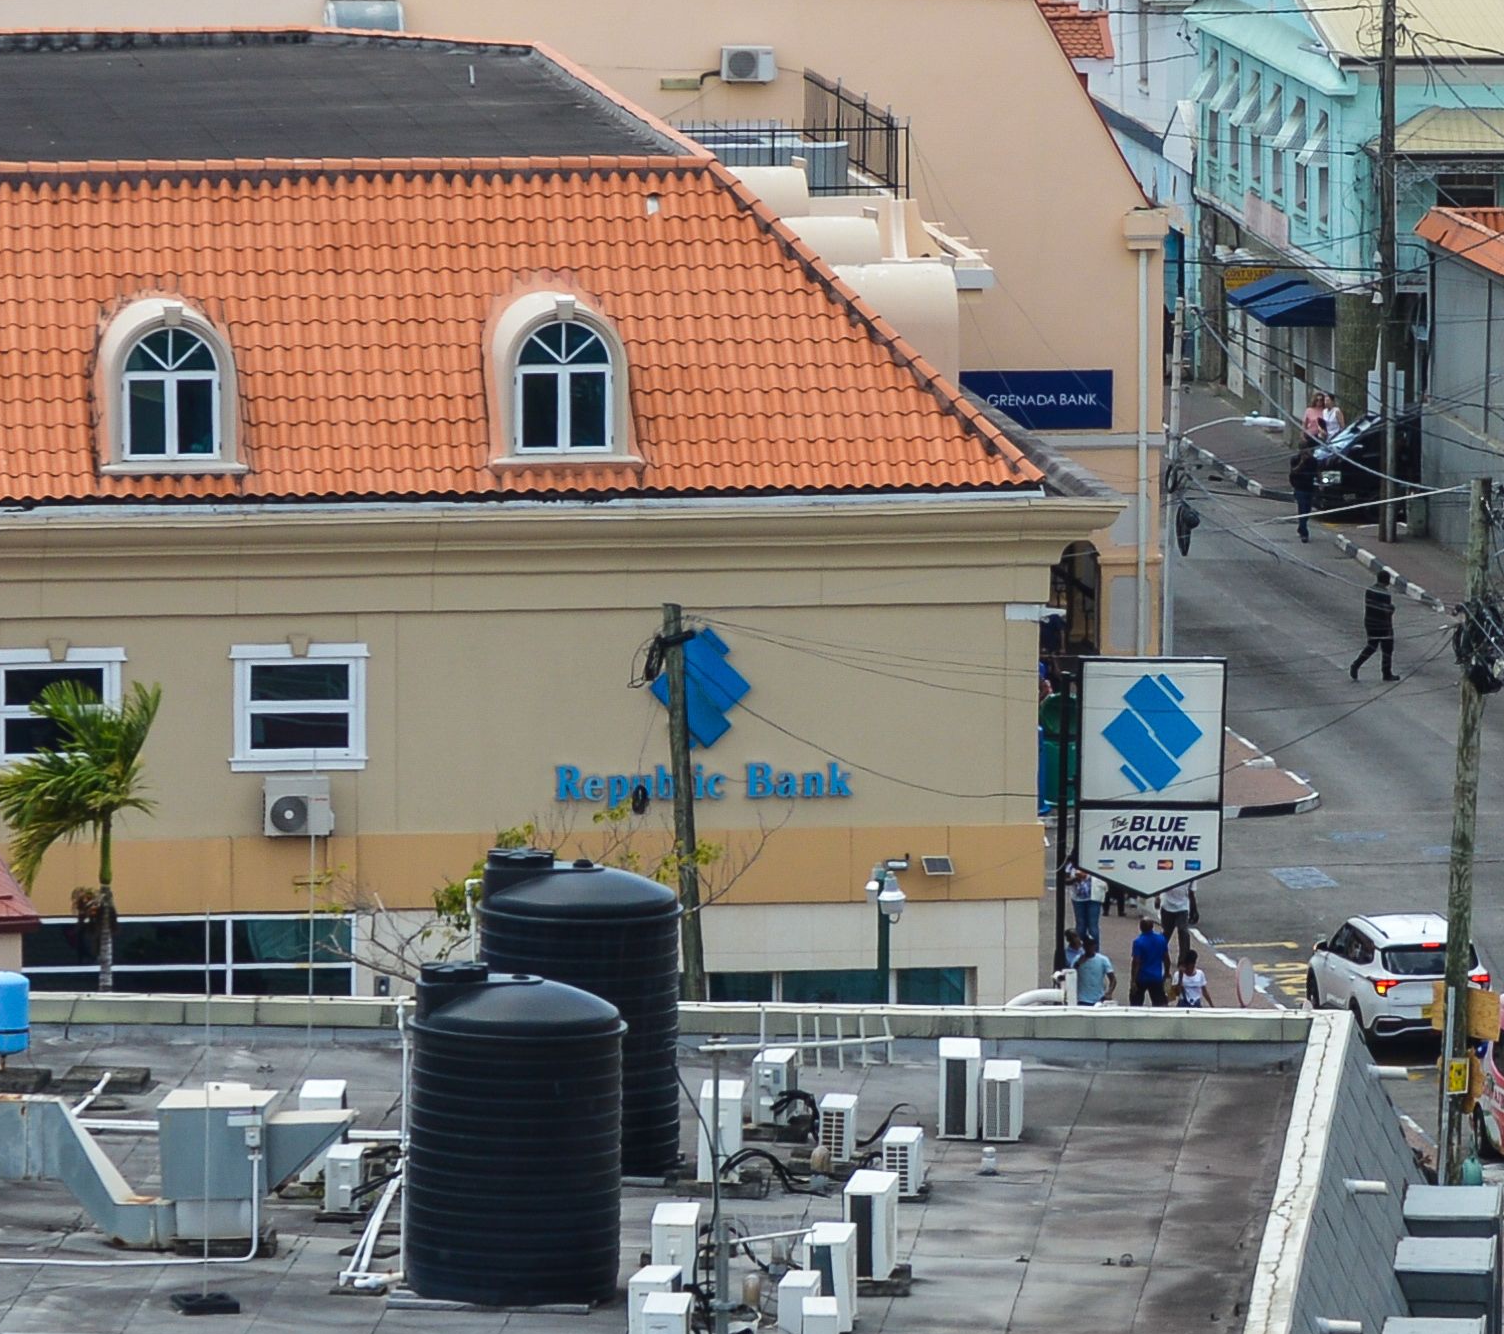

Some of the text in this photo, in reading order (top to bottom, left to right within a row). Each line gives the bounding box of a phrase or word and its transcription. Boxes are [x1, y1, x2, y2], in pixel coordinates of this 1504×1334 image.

[986, 393, 1097, 407] GRENADA BANK
[555, 762, 853, 809] Repubic Bank
[1110, 815, 1188, 833] The BLUE
